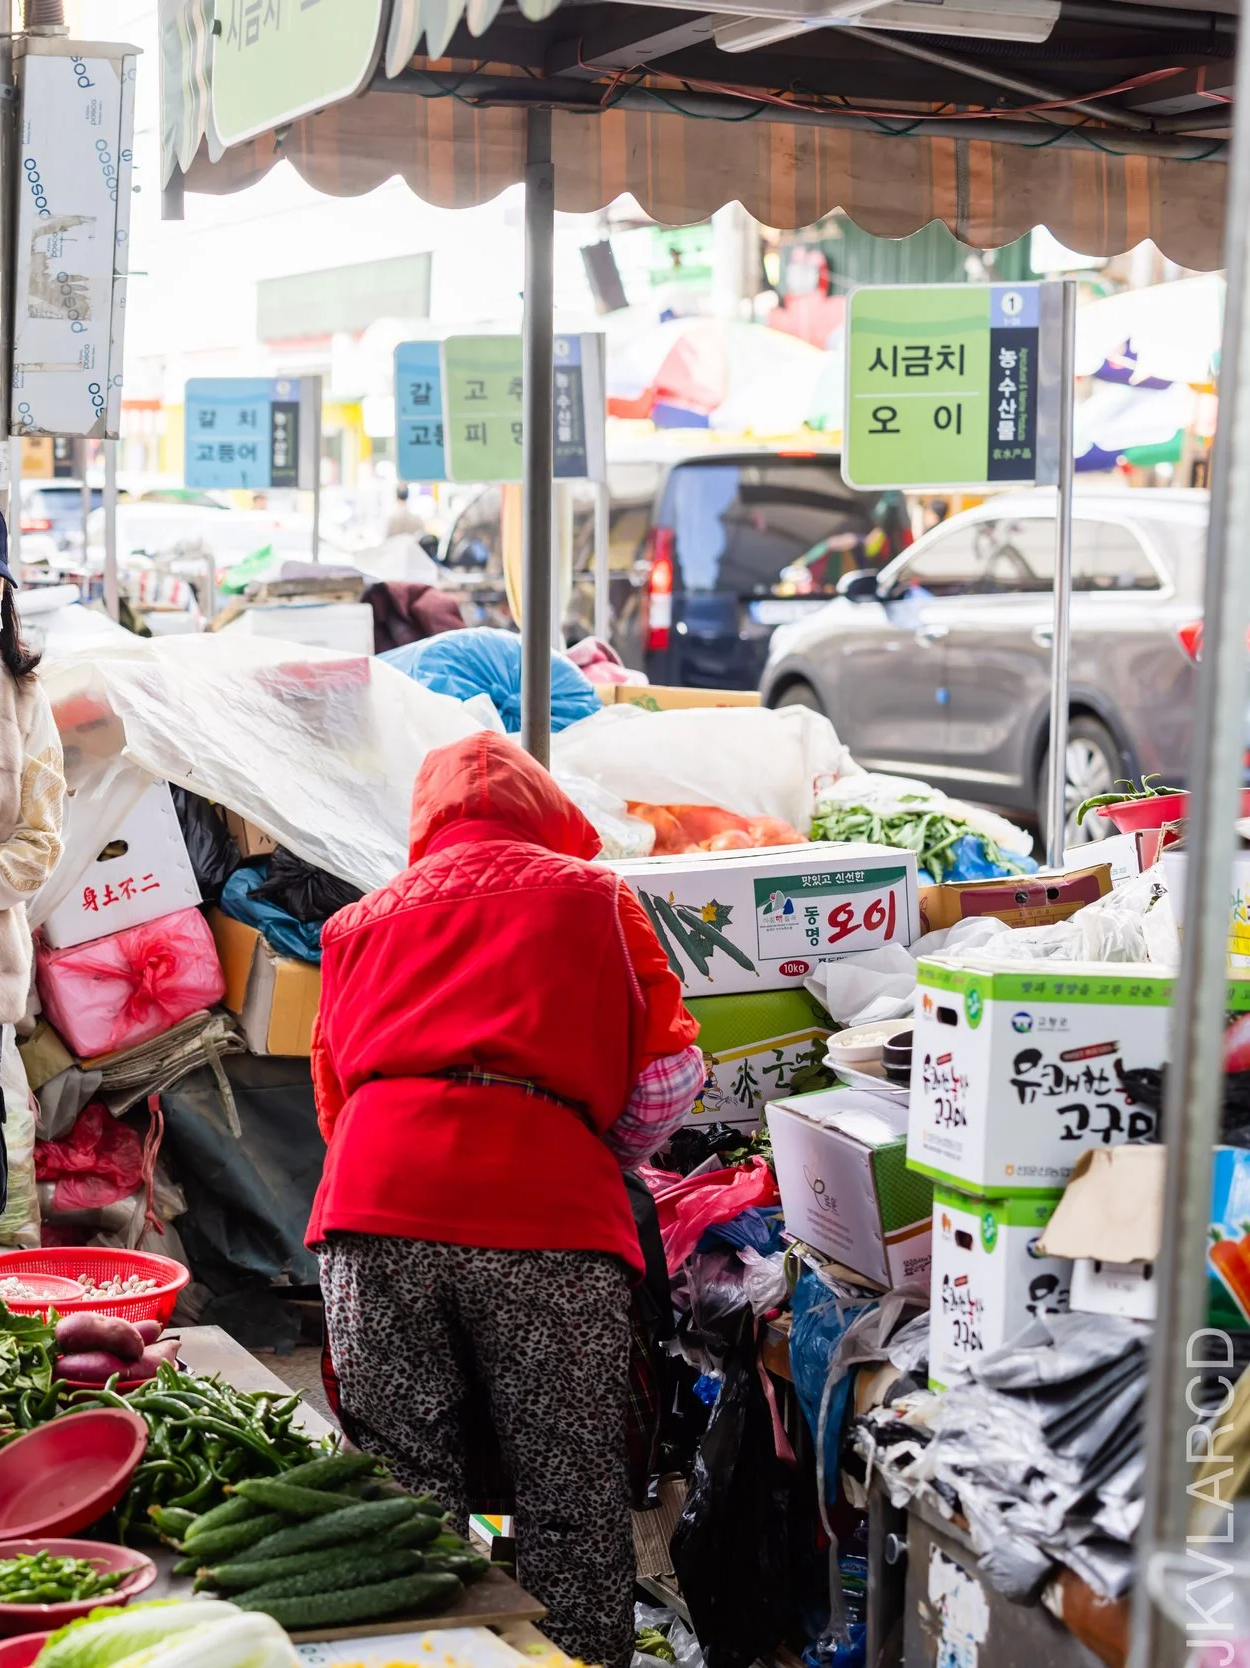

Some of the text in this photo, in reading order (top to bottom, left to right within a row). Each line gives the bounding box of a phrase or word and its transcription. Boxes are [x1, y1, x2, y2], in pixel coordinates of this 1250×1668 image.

[868, 344, 965, 377] 시금치
[196, 443, 257, 463] 고등어
[82, 873, 160, 912] 身土不二
[801, 871, 865, 887] 맛있고 신선한
[827, 890, 896, 944] 오이
[783, 963, 805, 974] 10kg
[1010, 1048, 1111, 1104] 유쾌한
